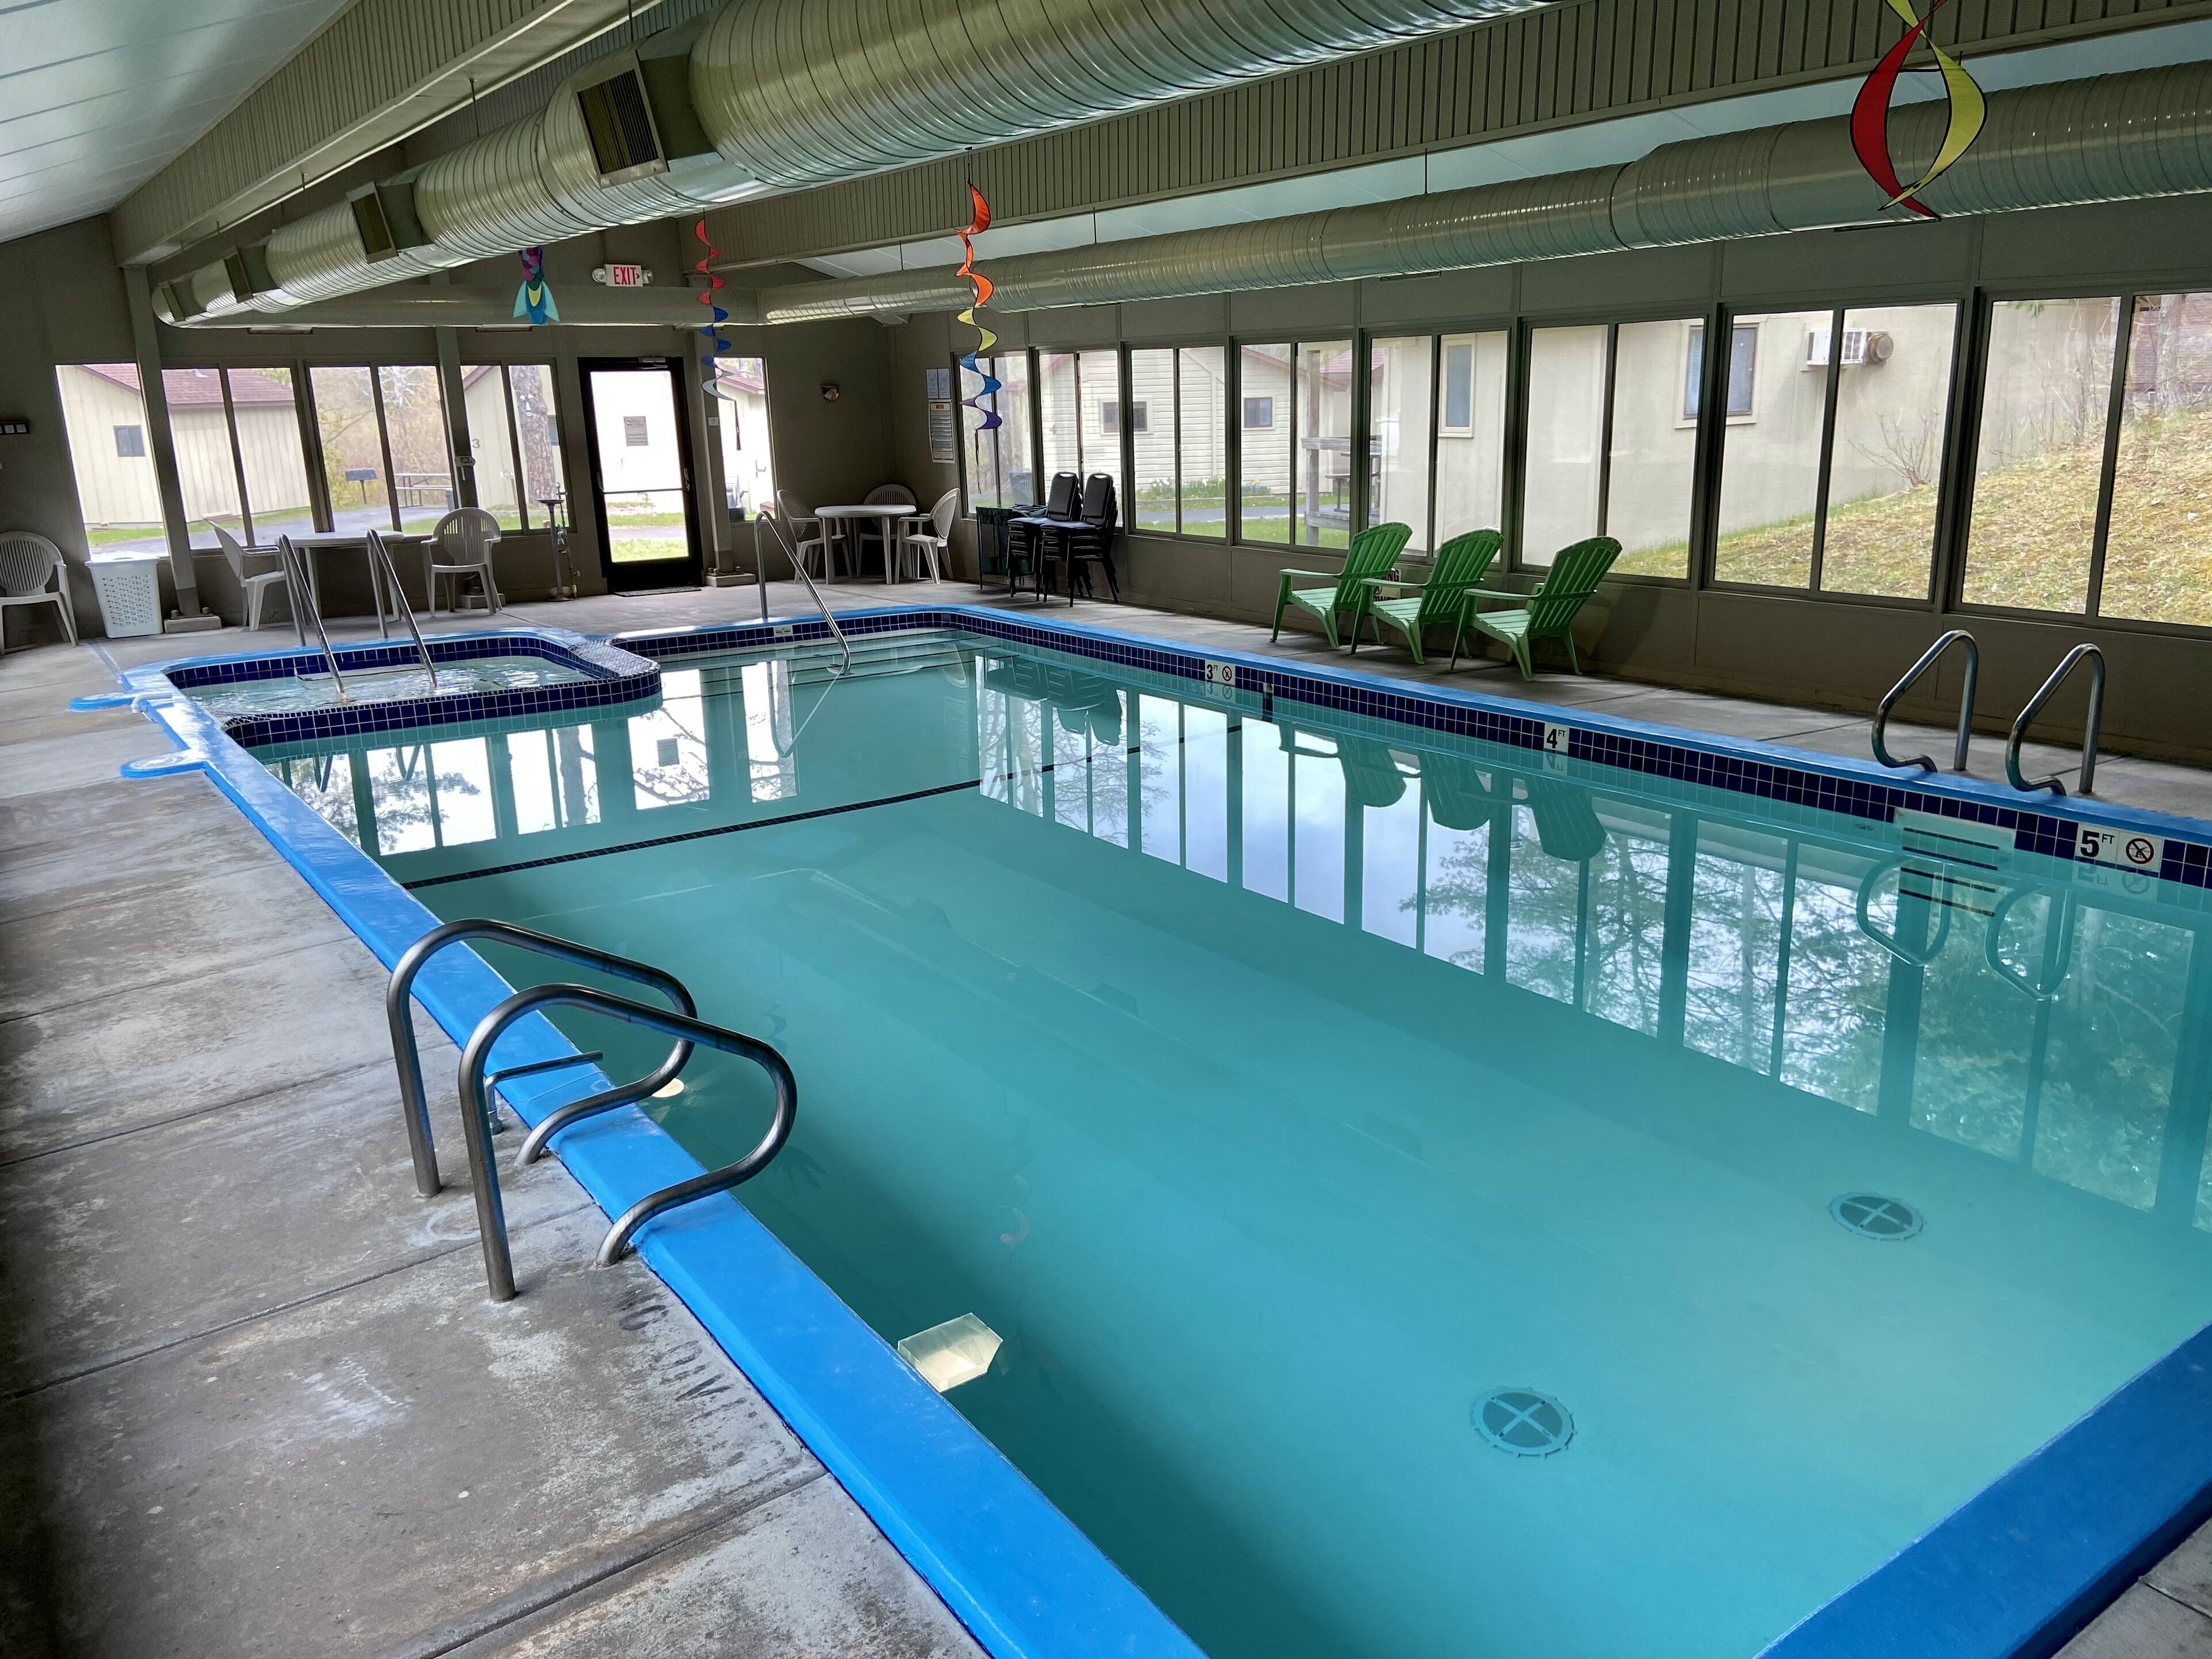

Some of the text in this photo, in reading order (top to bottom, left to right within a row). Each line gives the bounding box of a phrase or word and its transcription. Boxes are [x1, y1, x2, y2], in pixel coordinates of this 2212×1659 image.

[613, 267, 637, 285] EXIT
[472, 439, 480, 448] 3
[1206, 664, 1213, 680] 3
[1546, 729, 1566, 749] 4 FT
[2080, 830, 2115, 858] 5 FT
